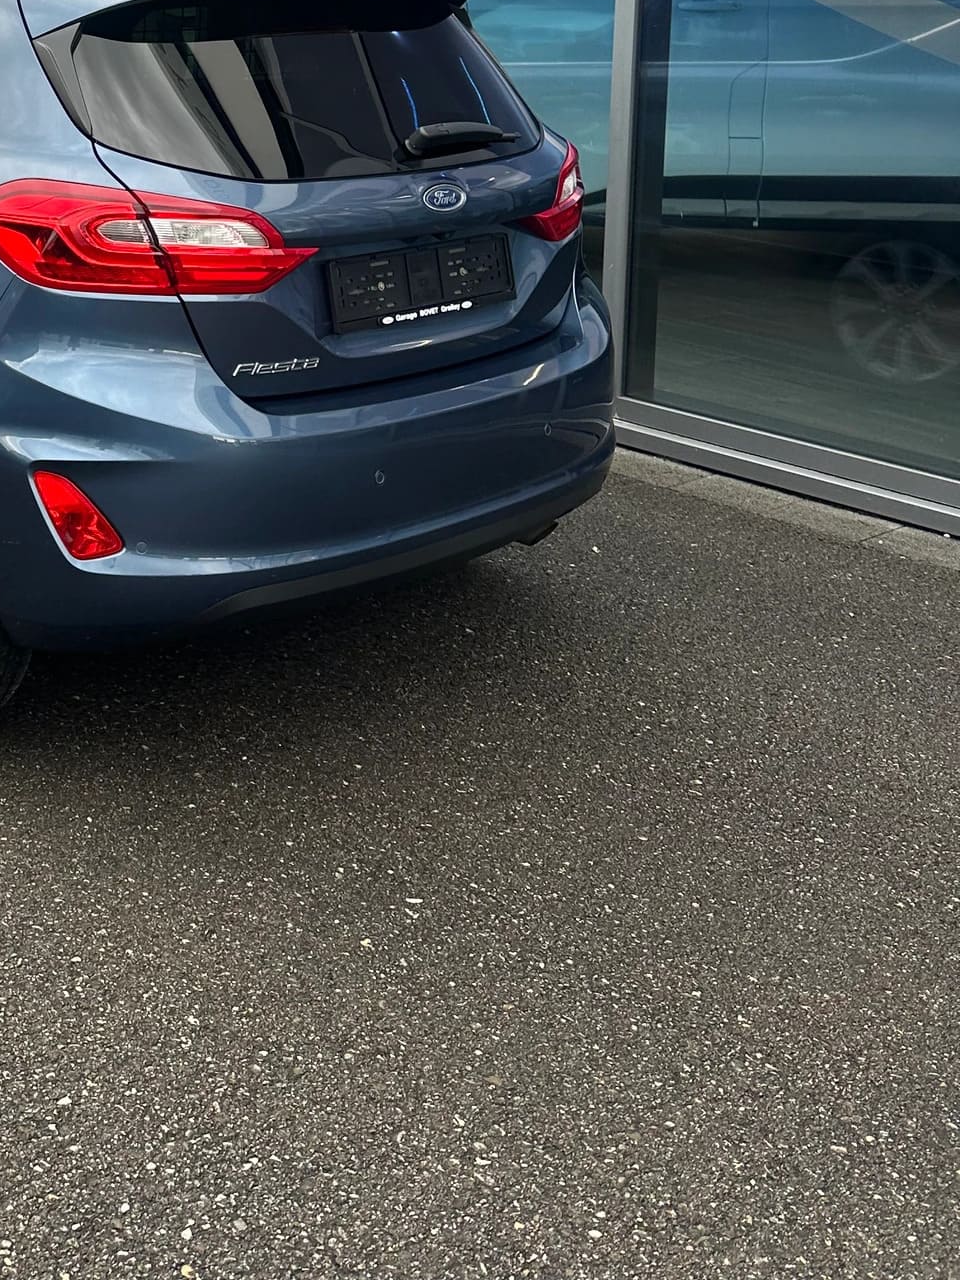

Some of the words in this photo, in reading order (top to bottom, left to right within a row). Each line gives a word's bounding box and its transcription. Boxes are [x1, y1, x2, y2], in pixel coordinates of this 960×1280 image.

[433, 190, 457, 206] Ford
[395, 312, 418, 322] Garage
[419, 306, 439, 317] BOVET
[232, 357, 320, 377] Fiesta
